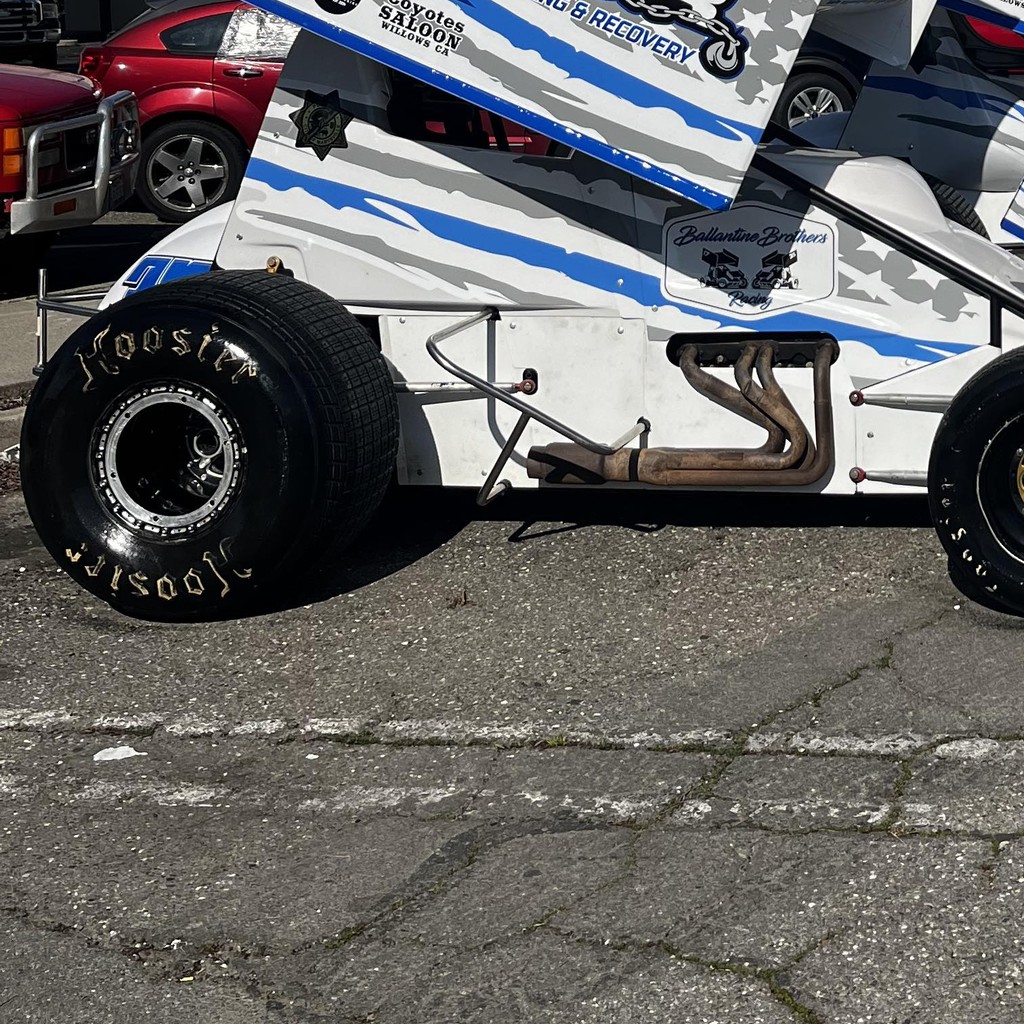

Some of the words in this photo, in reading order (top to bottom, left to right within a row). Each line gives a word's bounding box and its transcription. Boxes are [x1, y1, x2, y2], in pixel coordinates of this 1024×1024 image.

[378, 5, 461, 50] SALOON
[382, 21, 431, 48] WILLOWS
[435, 44, 449, 56] CA
[571, 1, 588, 20] &
[588, 6, 696, 65] RECOVERY
[673, 225, 759, 247] Ballantine
[757, 226, 828, 247] Brothers
[728, 291, 773, 310] Racing
[74, 323, 258, 393] Hoosier
